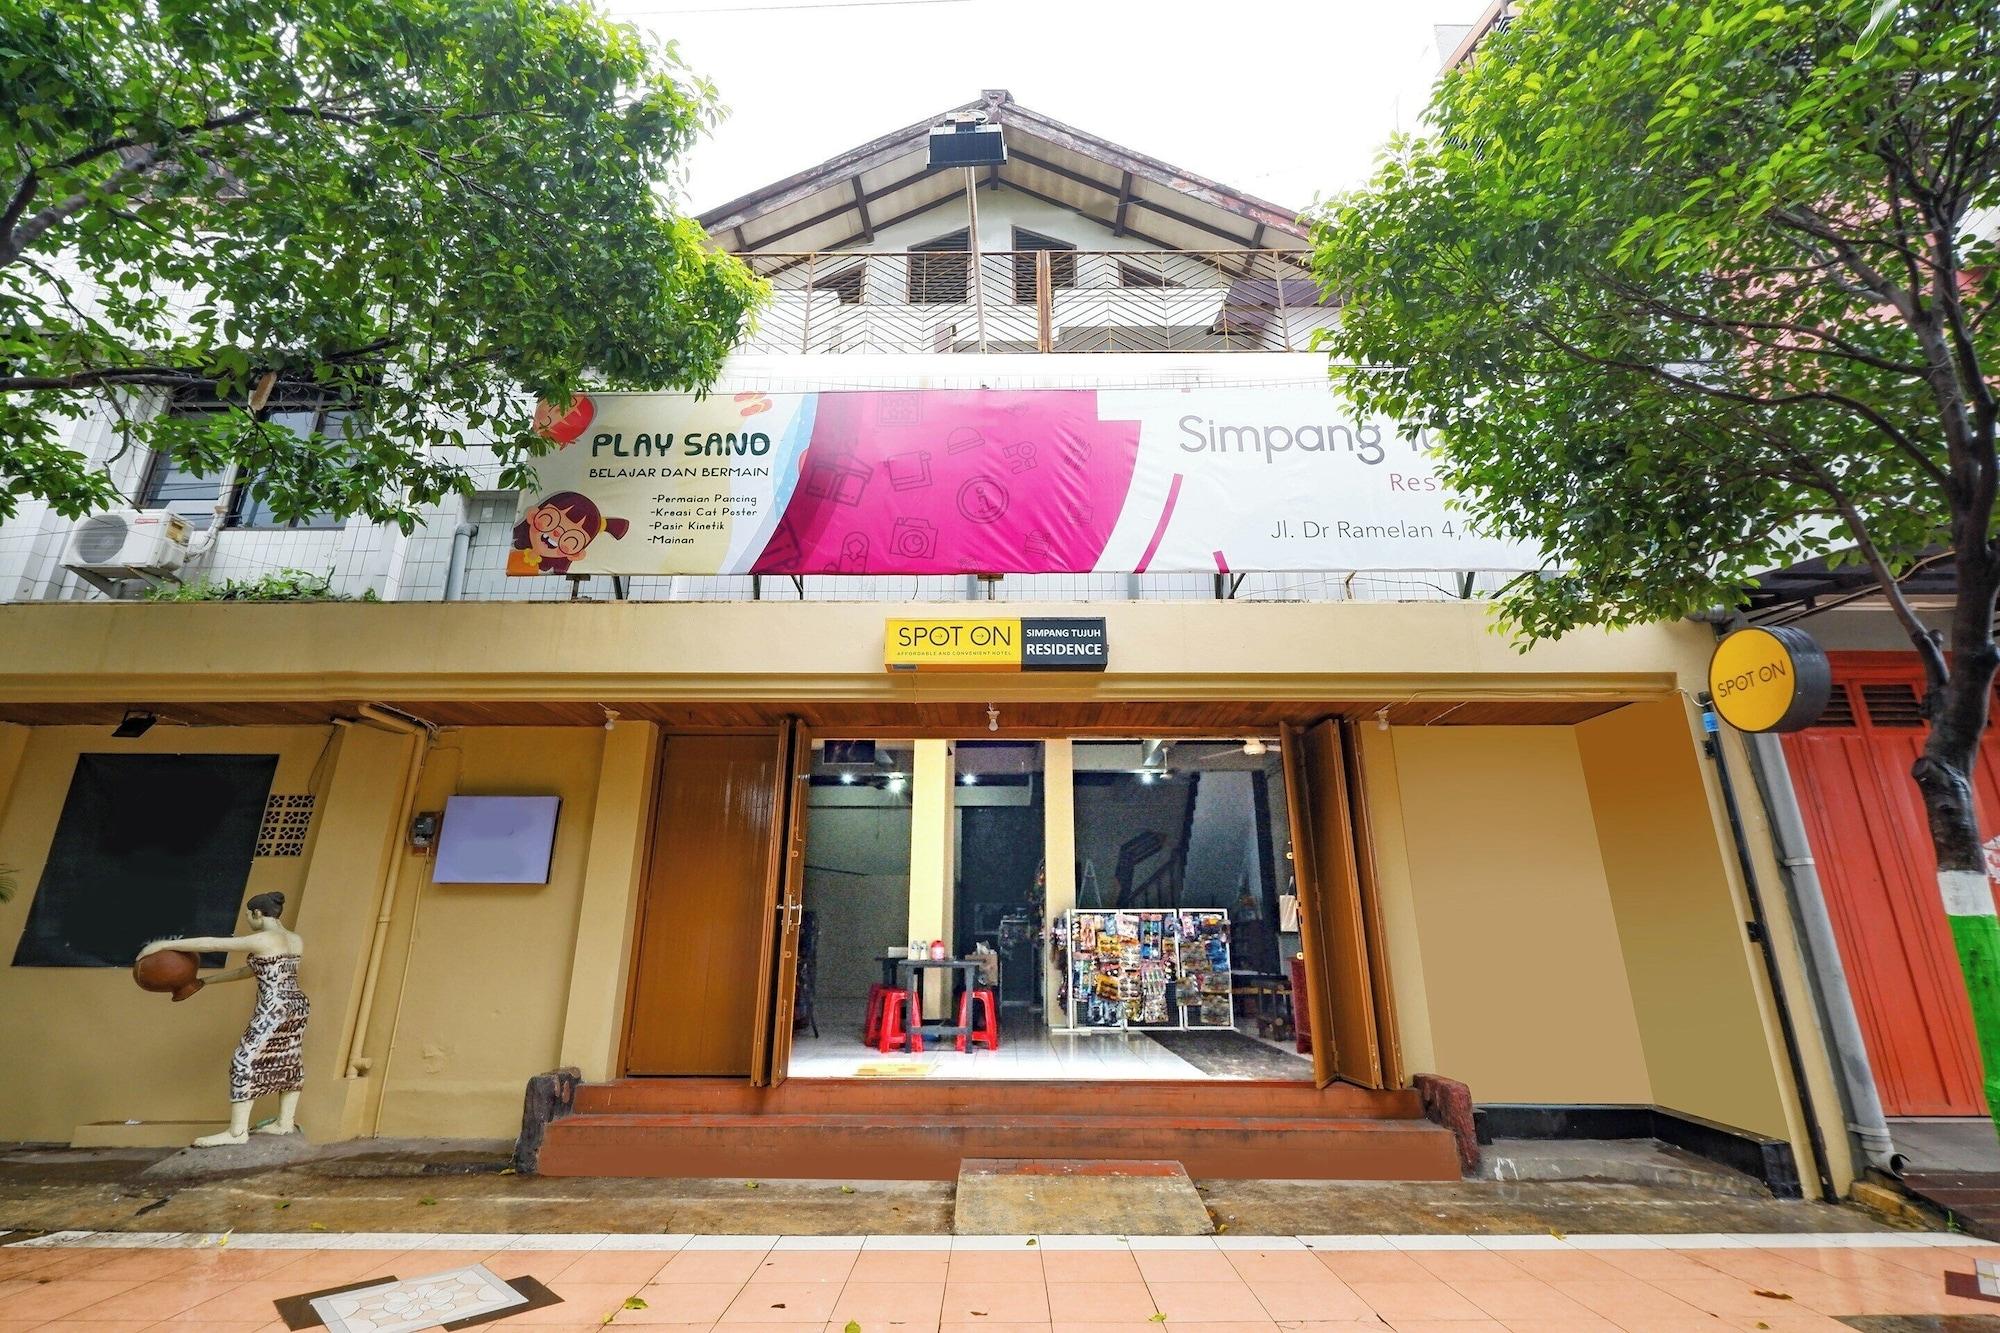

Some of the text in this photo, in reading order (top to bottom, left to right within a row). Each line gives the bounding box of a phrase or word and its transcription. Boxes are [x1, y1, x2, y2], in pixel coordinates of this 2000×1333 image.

[592, 432, 771, 458] PLAY SAND
[1178, 414, 1385, 466] Simpang
[589, 467, 769, 478] BELAJAR DAN BERMAIN
[714, 494, 757, 506] Pancing
[650, 507, 758, 517] -Kreasi Cat Poster
[649, 521, 725, 530] -Pasir Kinetik
[1271, 519, 1295, 539] Jl.
[1303, 520, 1330, 539] Dr
[1337, 519, 1434, 539] Ramelan
[1441, 520, 1462, 541] 4,
[647, 535, 695, 544] -Mainan
[898, 626, 1011, 647] SPOT ON
[1026, 628, 1101, 638] SIMPANG TUJUH
[1026, 643, 1103, 656] RESIDENCE
[1717, 660, 1786, 698] SPOT ON
